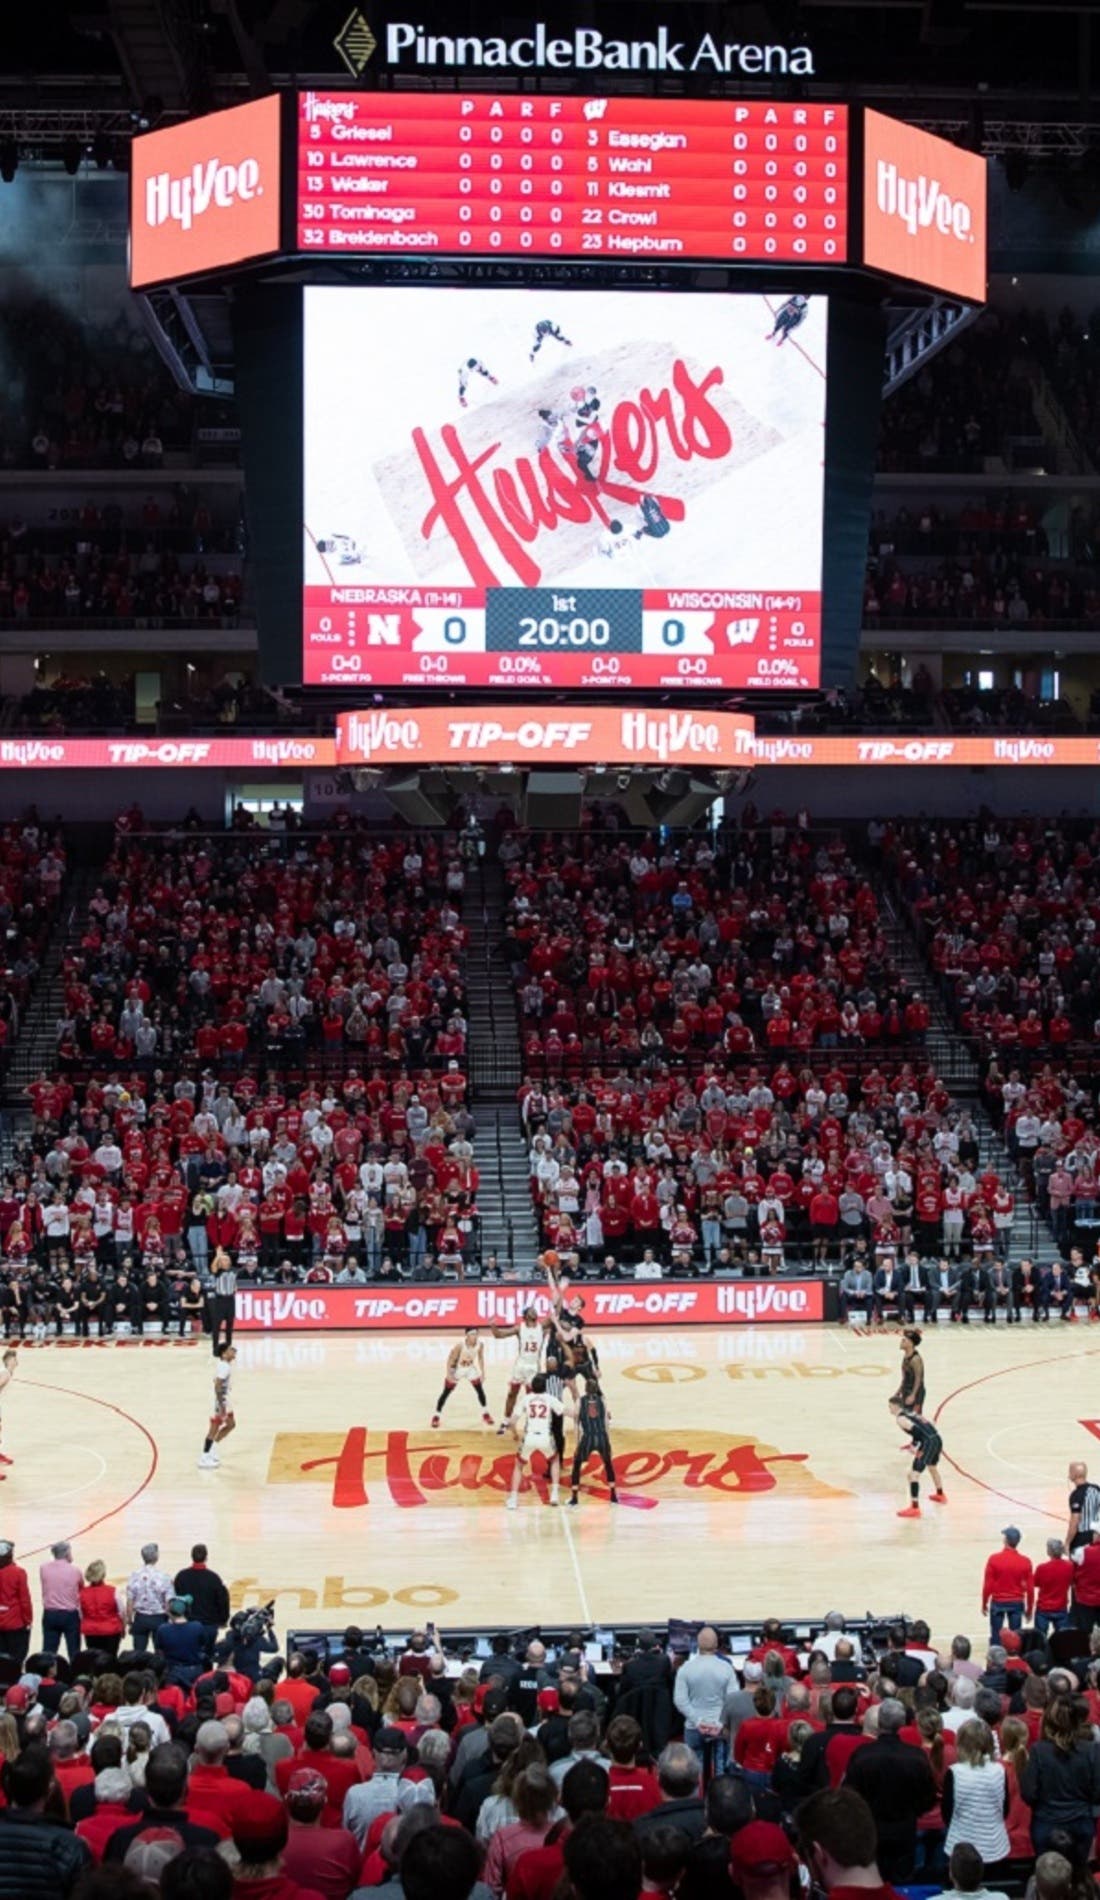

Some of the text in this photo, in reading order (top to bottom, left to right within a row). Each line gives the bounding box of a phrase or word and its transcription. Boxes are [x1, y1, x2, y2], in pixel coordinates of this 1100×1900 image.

[690, 33, 814, 74] Arena
[462, 101, 473, 114] P
[490, 101, 502, 115] A
[522, 102, 533, 116] R
[550, 103, 561, 116] F
[736, 108, 748, 121] P
[765, 109, 777, 122] A
[794, 110, 806, 123] R
[824, 110, 834, 124] F
[311, 125, 320, 138] 5
[460, 127, 471, 141] 0
[491, 127, 502, 142] 0
[521, 128, 532, 142] 0
[551, 128, 562, 143] 0
[588, 130, 836, 151] 3 Essegian 0 0 0 0
[307, 151, 562, 169] 10 Lawrence 0 0 0 0
[609, 158, 651, 171] Wahl
[734, 160, 746, 174] 0
[765, 161, 777, 175] 0
[795, 162, 806, 176] 0
[825, 163, 836, 177] 0
[307, 176, 562, 194] 13 Walker 0 0 0 0
[587, 182, 598, 195] 11
[734, 184, 746, 199] 0
[765, 186, 777, 200] 0
[794, 186, 806, 202] 0
[825, 188, 835, 203] 0
[304, 204, 561, 223] 30 Tominaga 0 0 0 0
[582, 209, 836, 229] 22 Crowl 0 0 0 0
[304, 229, 561, 247] 32 Breidenbach 0 0 0 0
[583, 234, 602, 248] 23
[733, 237, 746, 251] 0
[765, 238, 776, 252] 0
[793, 239, 806, 252] 0
[824, 239, 836, 254] 0
[411, 359, 733, 588] Huskers
[331, 588, 421, 604] NEBRASKA
[553, 595, 576, 612] 1st
[667, 592, 763, 609] WISCONSIN
[319, 617, 332, 632] 0
[367, 614, 401, 645] N
[444, 616, 467, 644] 0
[518, 618, 611, 646] 20:00
[662, 618, 685, 647] 0
[790, 621, 805, 637] 0
[331, 655, 362, 671] 0-0
[419, 655, 448, 672] 0-0
[499, 656, 541, 673] 0.0%
[591, 657, 620, 674] 0-0
[677, 658, 707, 675] 0-0
[757, 658, 799, 675] 0.0%
[448, 722, 591, 749] TIP-OFF
[108, 743, 210, 762] TIP-OFF
[857, 742, 953, 760] TIP-OFF
[355, 1299, 458, 1317] TIP-OFF
[594, 1292, 698, 1314] TIP-OFF
[525, 1342, 538, 1352] 13
[529, 1404, 547, 1419] 32
[301, 1427, 808, 1508] Huskers
[230, 1576, 460, 1609] fnbo
